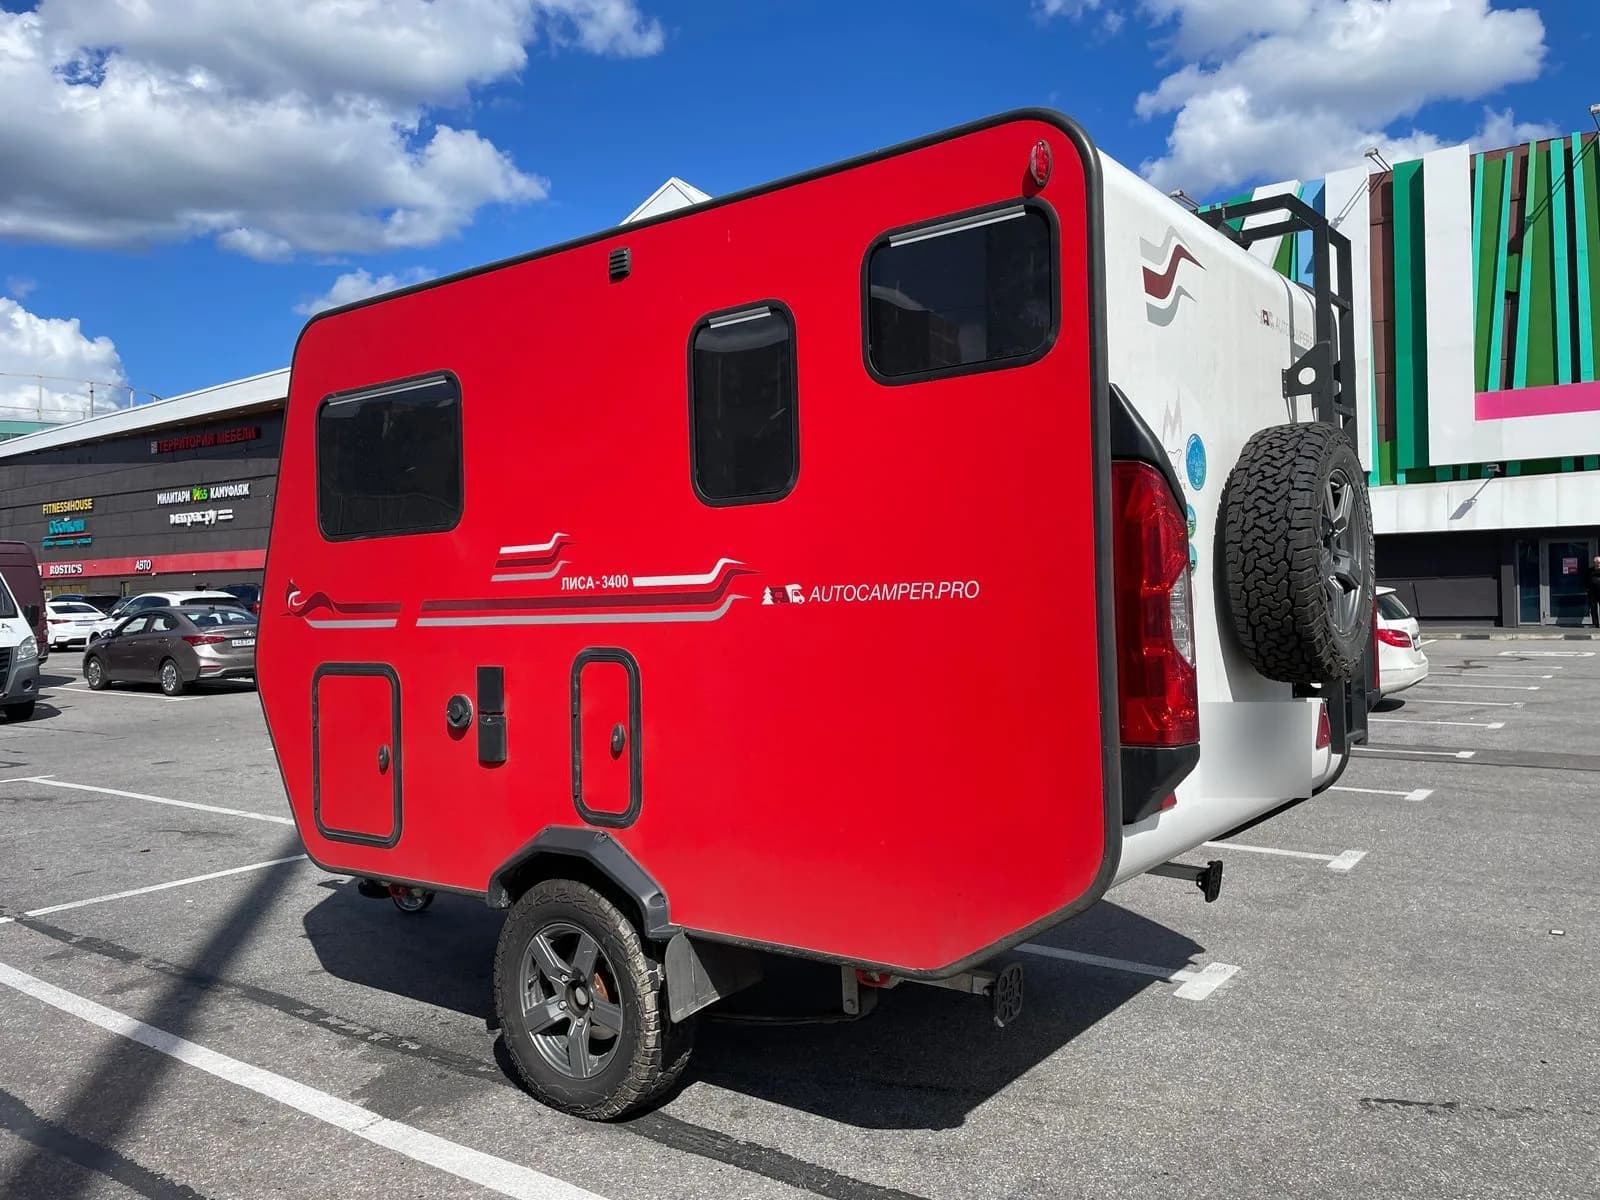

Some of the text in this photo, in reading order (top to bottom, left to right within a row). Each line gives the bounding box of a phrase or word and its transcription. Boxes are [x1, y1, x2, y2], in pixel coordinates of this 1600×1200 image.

[159, 432, 214, 452] ТЕРРИТОРИЯ
[217, 425, 256, 445] МЕБЕЛИ
[157, 490, 191, 505] МИЛИТАРИ
[210, 483, 250, 499] КАМУФЛЯЖ
[43, 499, 93, 515] FITNESS HOUSE
[49, 564, 82, 575] ROSTIC'S
[135, 559, 151, 571] АВТО
[809, 580, 980, 602] AUTOCAMPER.PRO
